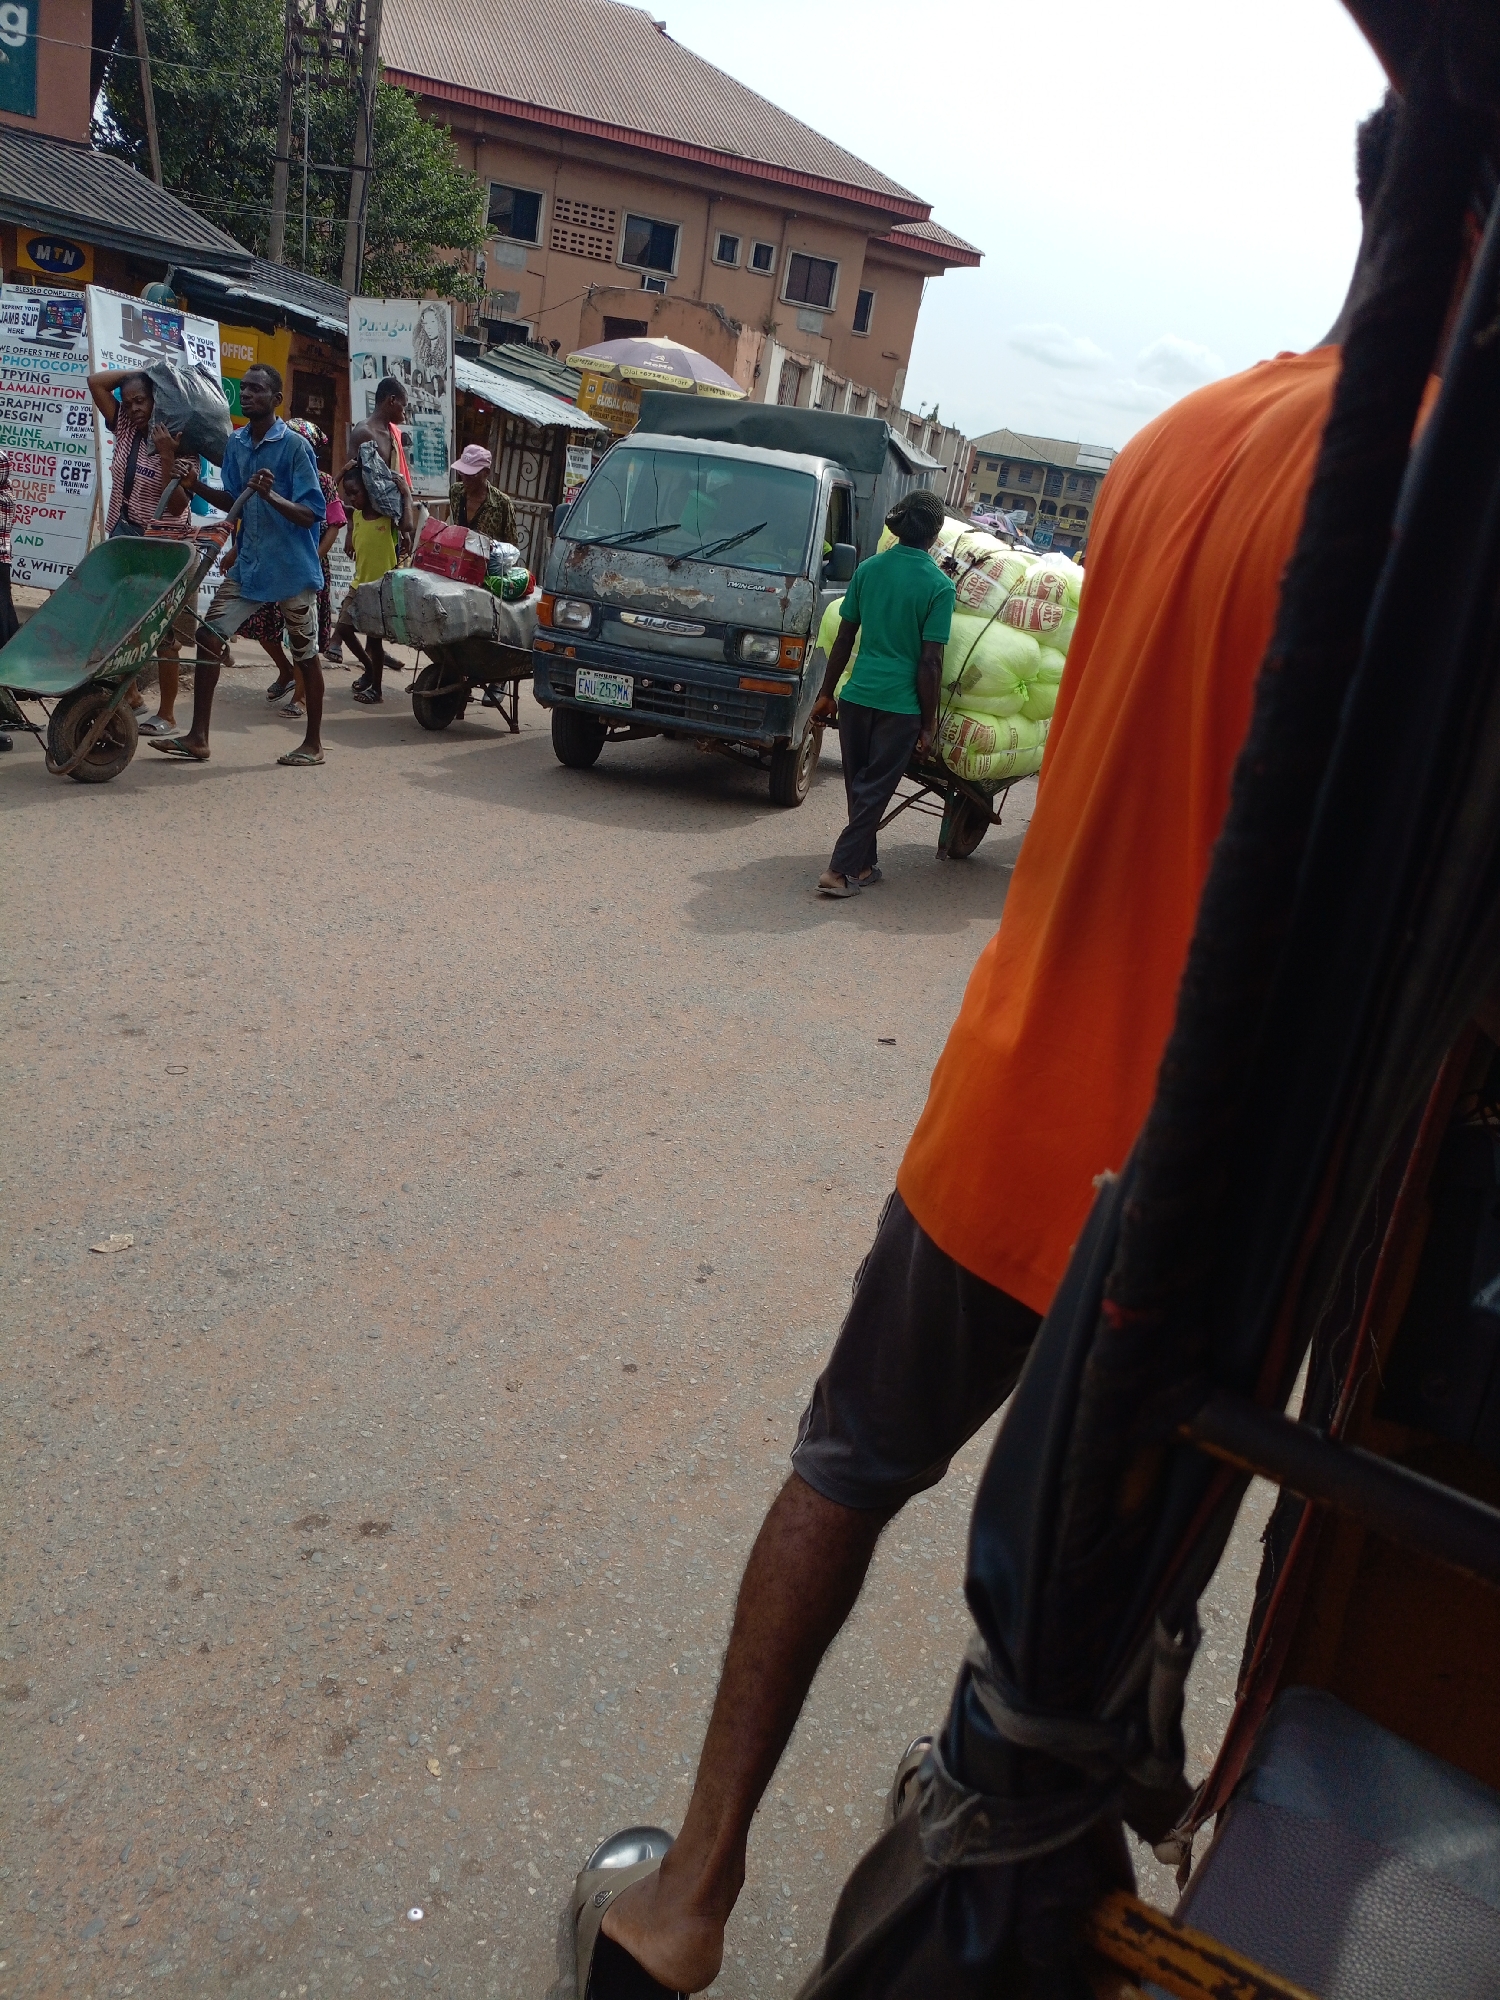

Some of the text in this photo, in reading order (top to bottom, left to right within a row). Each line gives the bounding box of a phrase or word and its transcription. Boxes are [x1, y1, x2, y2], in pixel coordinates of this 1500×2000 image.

[36, 244, 76, 266] MTN
[15, 285, 42, 294] BLESSED
[0, 311, 39, 327] JAMB SLIP
[7, 327, 25, 335] HERE
[187, 333, 214, 347] DO YOUR
[13, 346, 43, 357] OFFERS
[45, 350, 61, 359] THE
[100, 348, 114, 360] WE
[116, 353, 143, 368] OFFER
[188, 340, 216, 361] CBT
[221, 341, 254, 362] OFFICE
[3, 354, 88, 374] PHOTOCOPY
[623, 368, 638, 376] Dial
[643, 360, 674, 371] MoMo
[1, 368, 50, 384] TPYING
[0, 381, 86, 400] LAMAINTION
[0, 396, 63, 414] GRAPHICS
[596, 394, 621, 410] GLOBAL
[66, 411, 94, 427] CBT
[0, 434, 87, 455] EGISTRATION
[8, 450, 57, 466] ECKING
[74, 460, 91, 468] YOUR
[60, 466, 92, 482] CBT
[12, 479, 56, 494] OURED
[60, 480, 89, 489] TRAINING
[65, 487, 81, 495] HERE
[16, 504, 67, 520] SSPORT
[14, 534, 44, 546] AND
[31, 559, 74, 576] WHITE
[199, 584, 220, 595] HIT
[727, 581, 747, 590] TWIN
[747, 584, 767, 592] CAM
